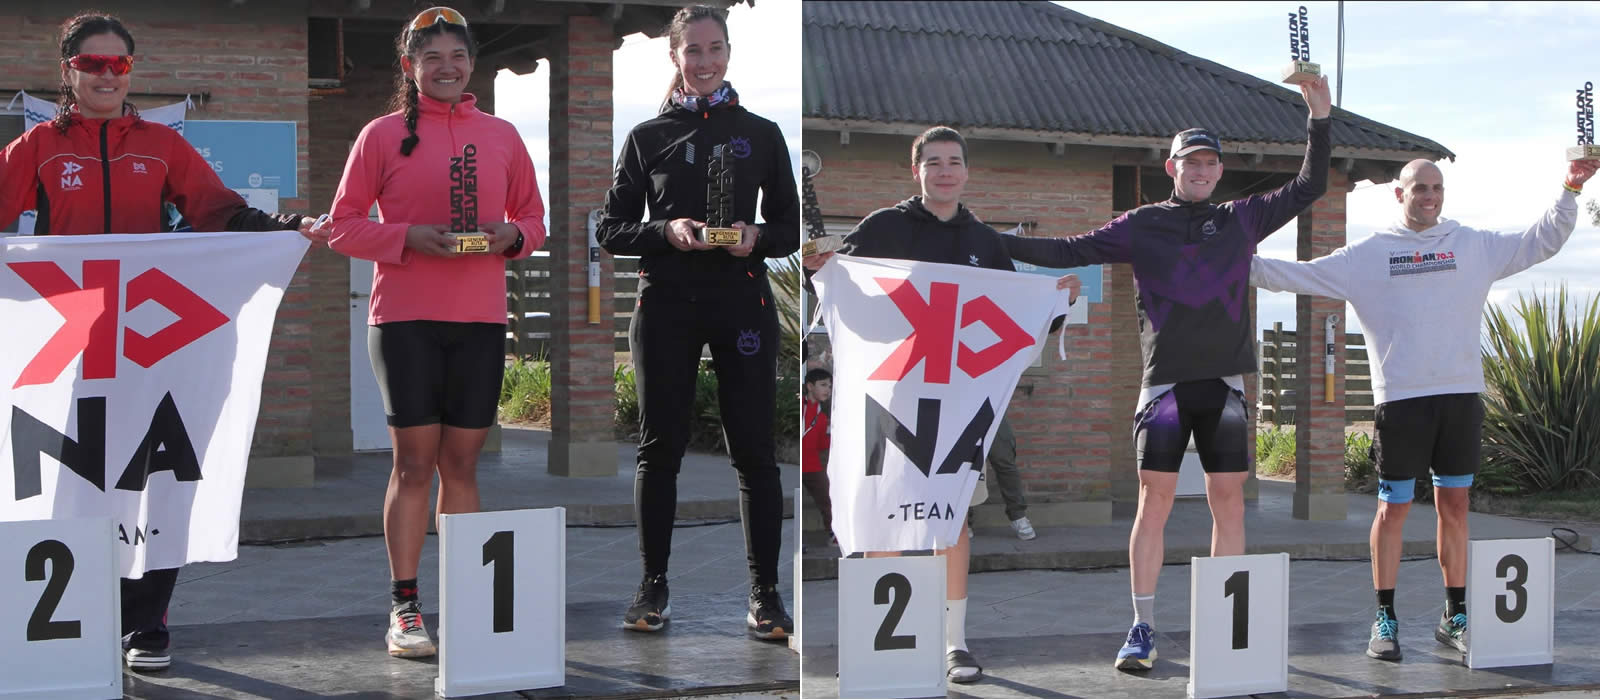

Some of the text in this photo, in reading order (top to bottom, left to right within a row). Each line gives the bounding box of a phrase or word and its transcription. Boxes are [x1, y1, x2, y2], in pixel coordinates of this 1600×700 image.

[1288, 13, 1300, 60] UATLON
[1436, 251, 1455, 261] 70.3
[25, 540, 81, 641] 2
[482, 530, 515, 634] 1
[873, 572, 917, 651] 2
[1224, 570, 1250, 650] 1
[1495, 553, 1529, 624] 3
